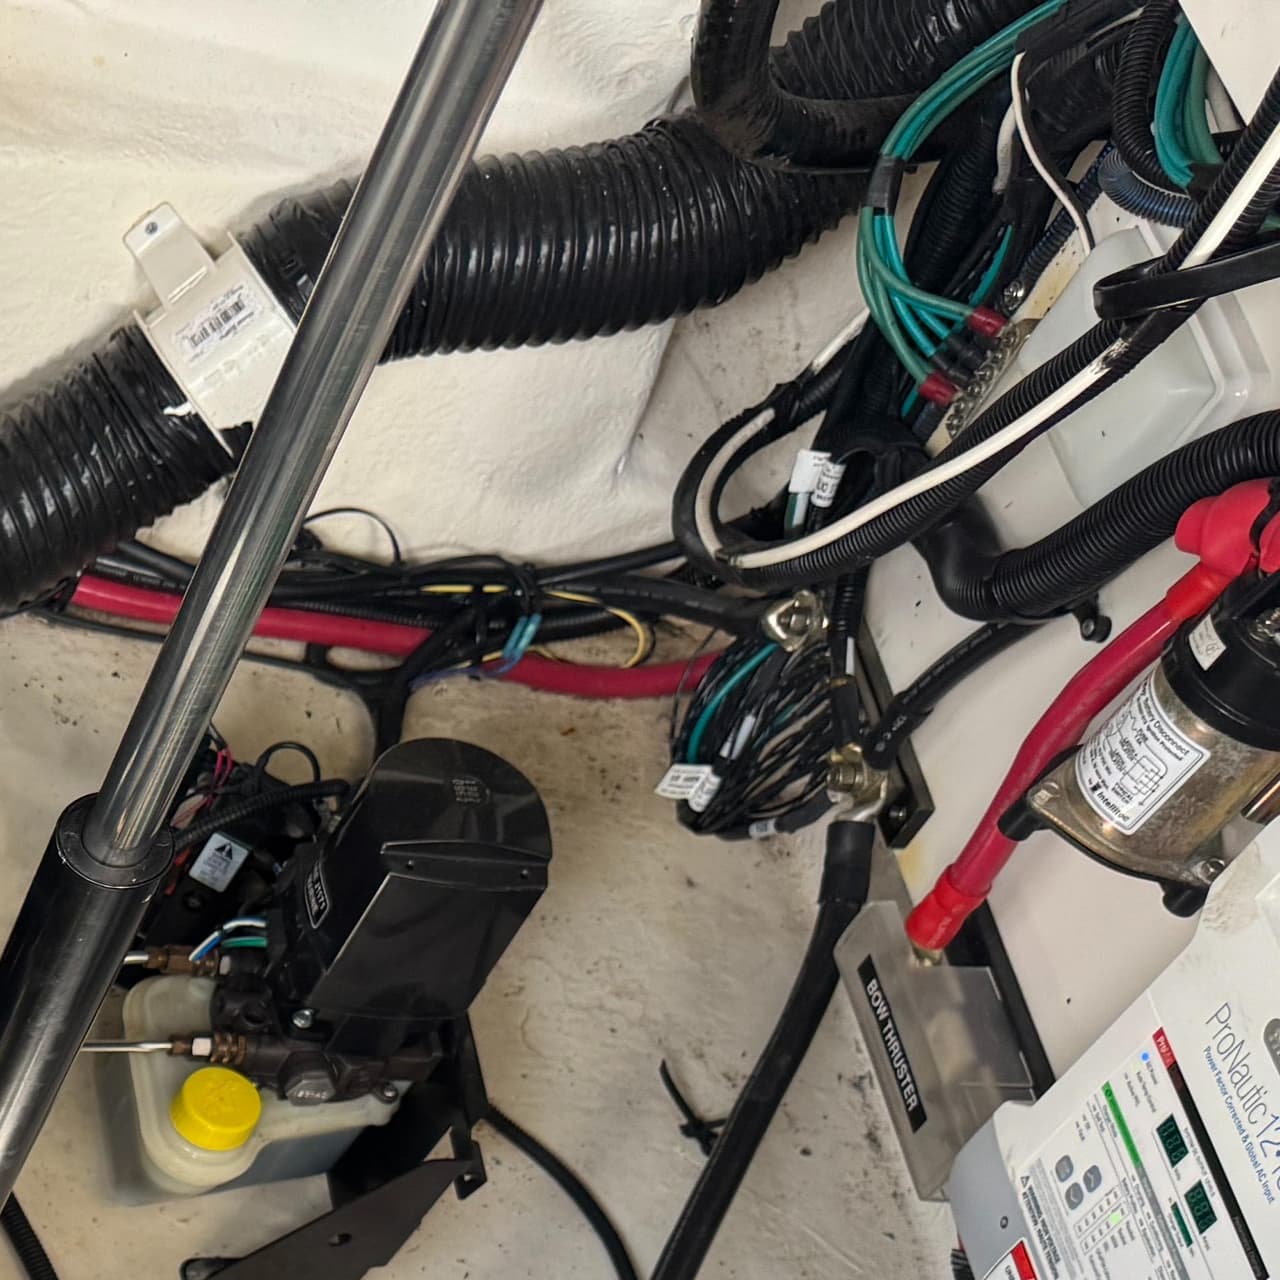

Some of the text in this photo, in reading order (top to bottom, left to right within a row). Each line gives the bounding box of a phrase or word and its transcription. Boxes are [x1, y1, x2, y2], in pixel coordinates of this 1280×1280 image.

[1152, 720, 1191, 757] Disconnect
[862, 977, 921, 1112] BOW THRUSTER
[1199, 1044, 1221, 1073] Power
[1205, 1002, 1268, 1125] ProNautic
[1210, 1069, 1232, 1098] Factor
[1220, 1094, 1249, 1136] Corrected
[1239, 1132, 1252, 1144] &
[1241, 1140, 1264, 1170] Global
[1253, 1166, 1268, 1183] AC
[1260, 1172, 1275, 1206] Input
